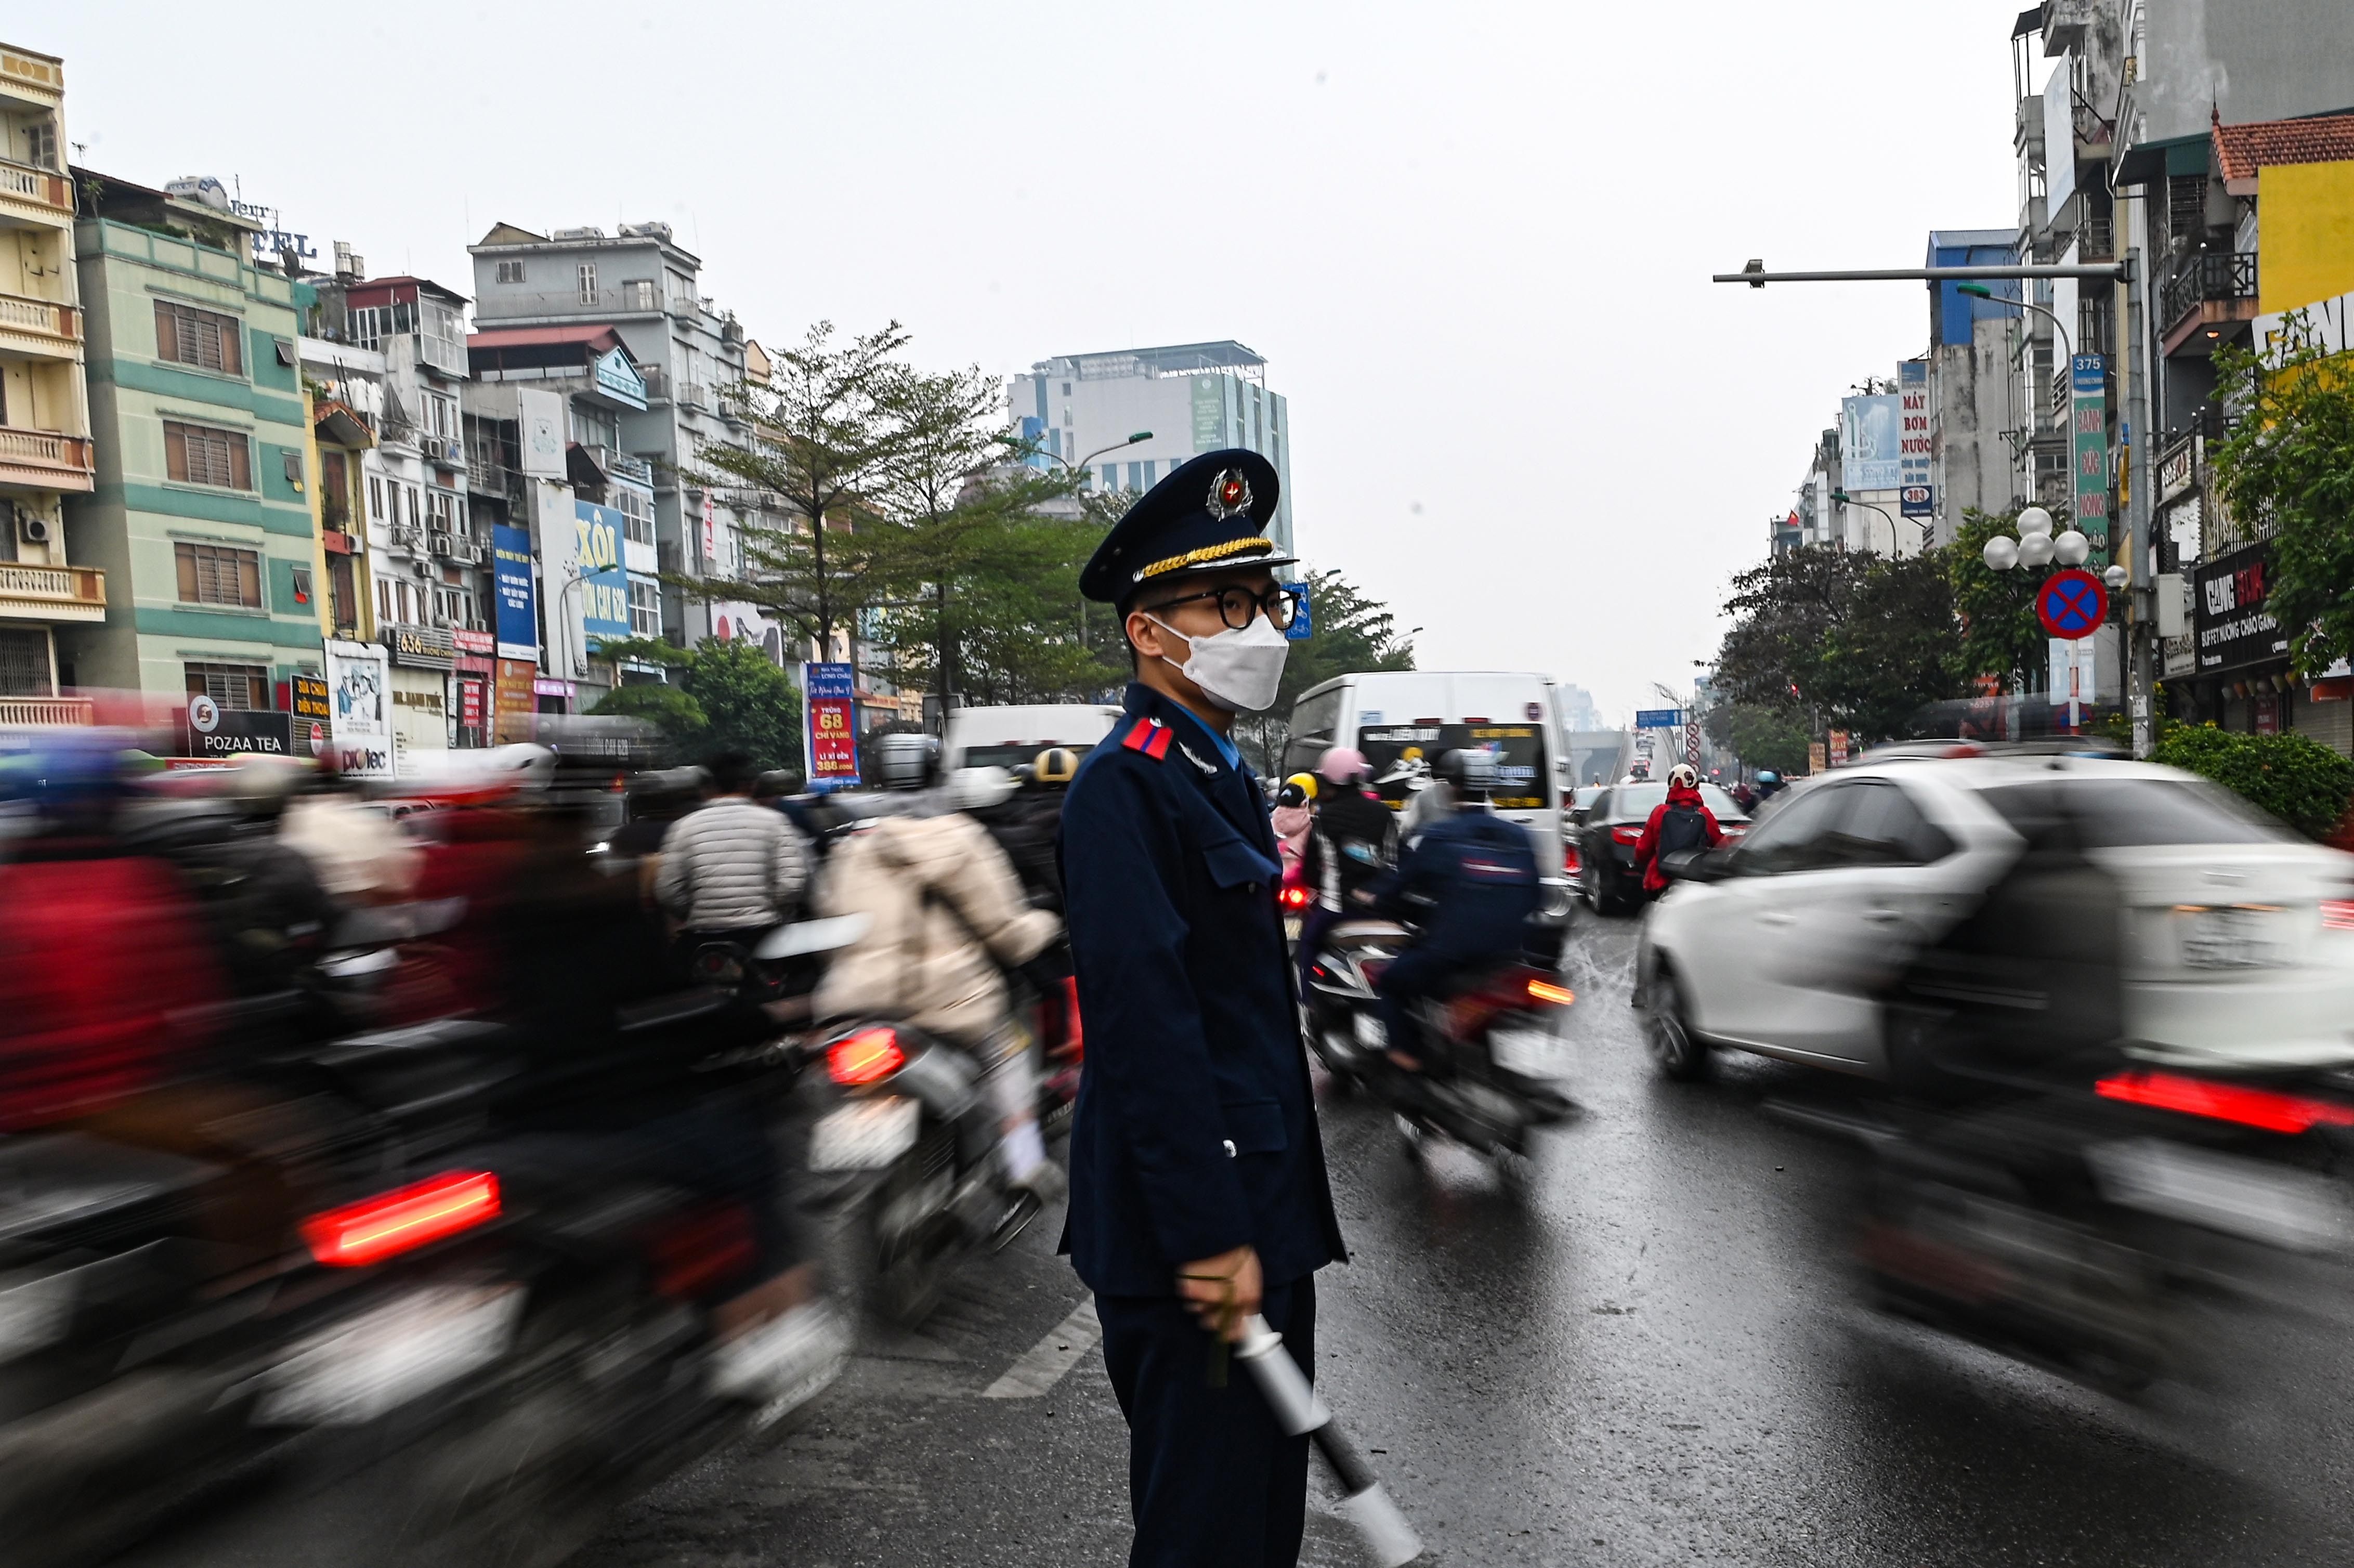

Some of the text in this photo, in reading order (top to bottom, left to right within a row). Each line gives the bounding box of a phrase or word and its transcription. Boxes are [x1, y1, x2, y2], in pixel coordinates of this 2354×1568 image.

[2076, 358, 2101, 371] 375
[1903, 391, 1925, 410] MÁY
[1904, 415, 1927, 431] BƠM
[2077, 403, 2103, 434] BÁNH
[1902, 434, 1931, 454] NƯỚC
[576, 508, 618, 572] XÔI
[2205, 574, 2235, 616] GANG
[2201, 628, 2220, 648] BUFFET
[820, 714, 843, 729] 68
[205, 736, 282, 752] POZAA TEA
[342, 748, 386, 772] protec
